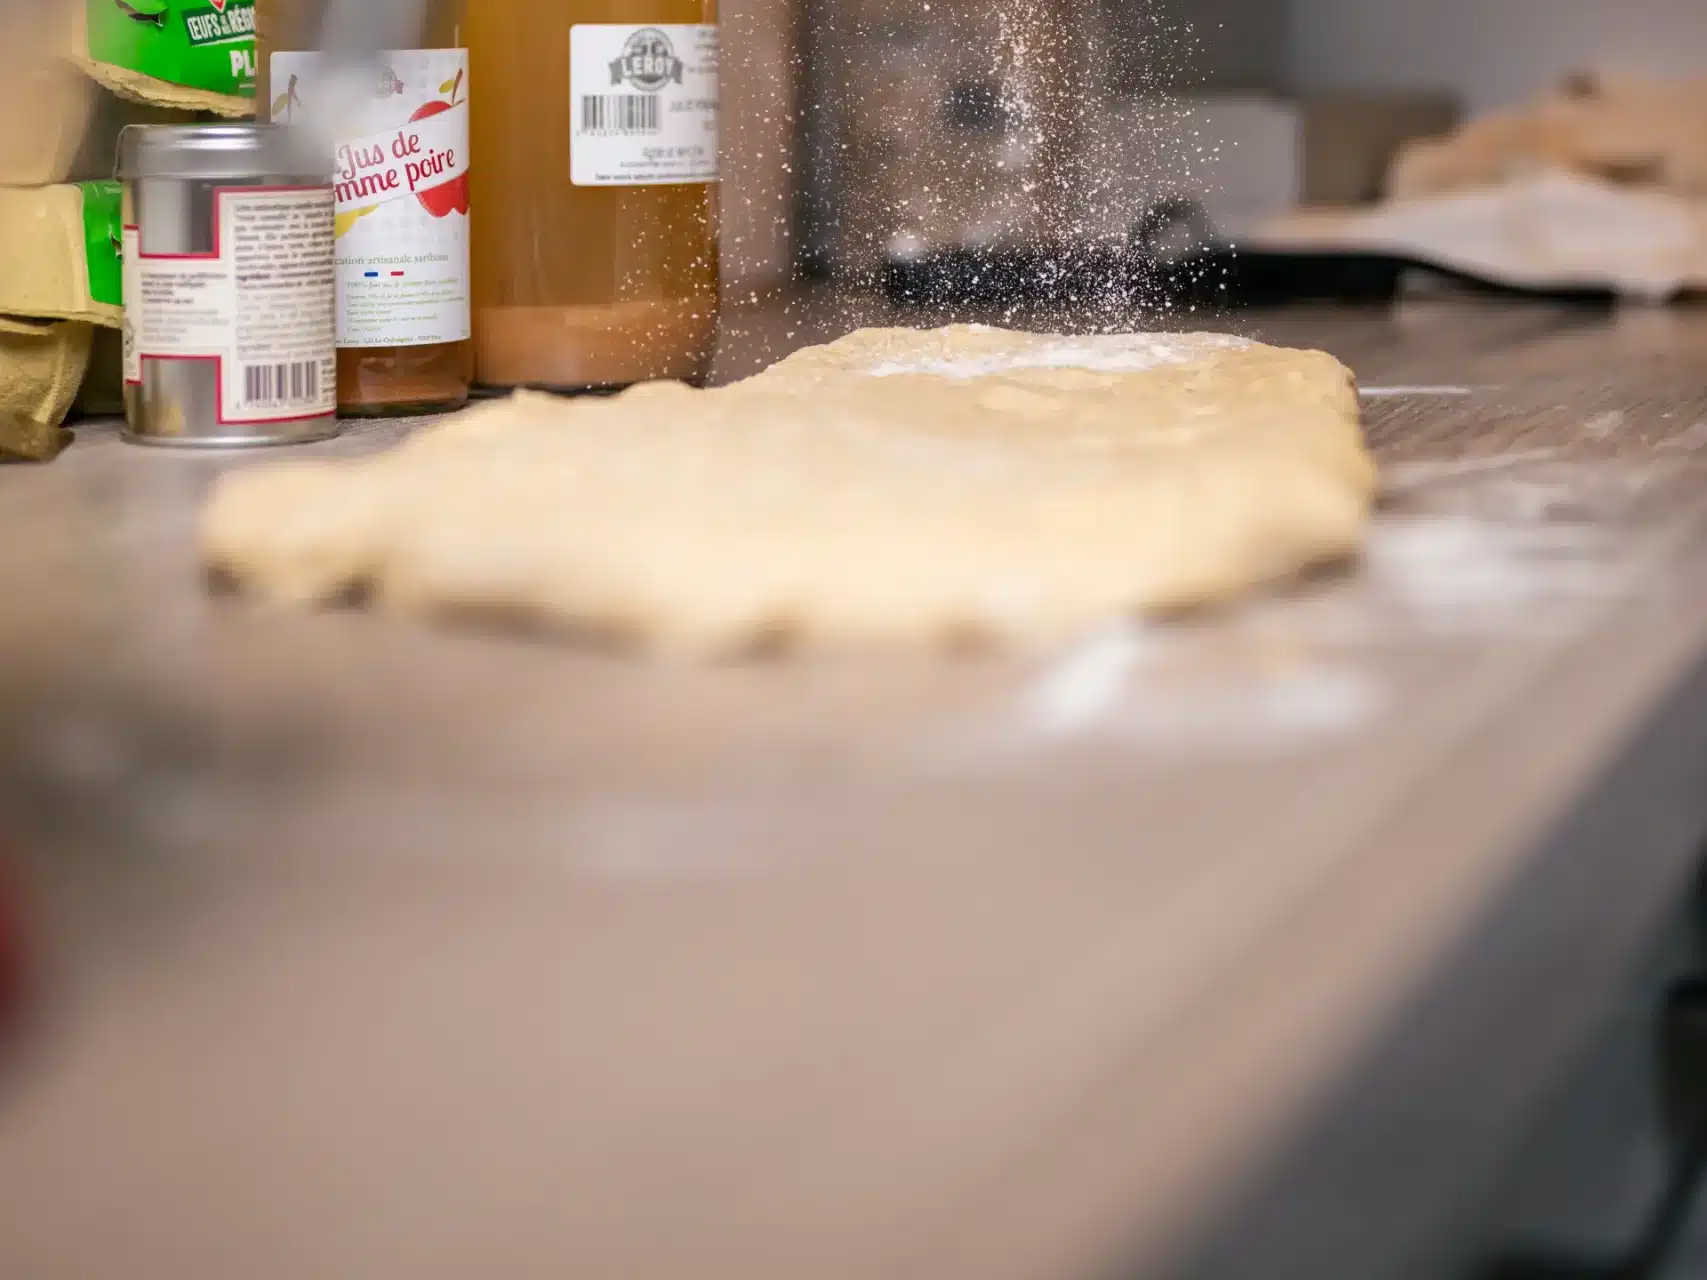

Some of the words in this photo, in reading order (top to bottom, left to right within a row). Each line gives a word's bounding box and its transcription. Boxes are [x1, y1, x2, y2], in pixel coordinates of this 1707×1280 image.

[337, 144, 385, 180] Jus
[391, 131, 422, 159] de
[404, 149, 456, 192] poire
